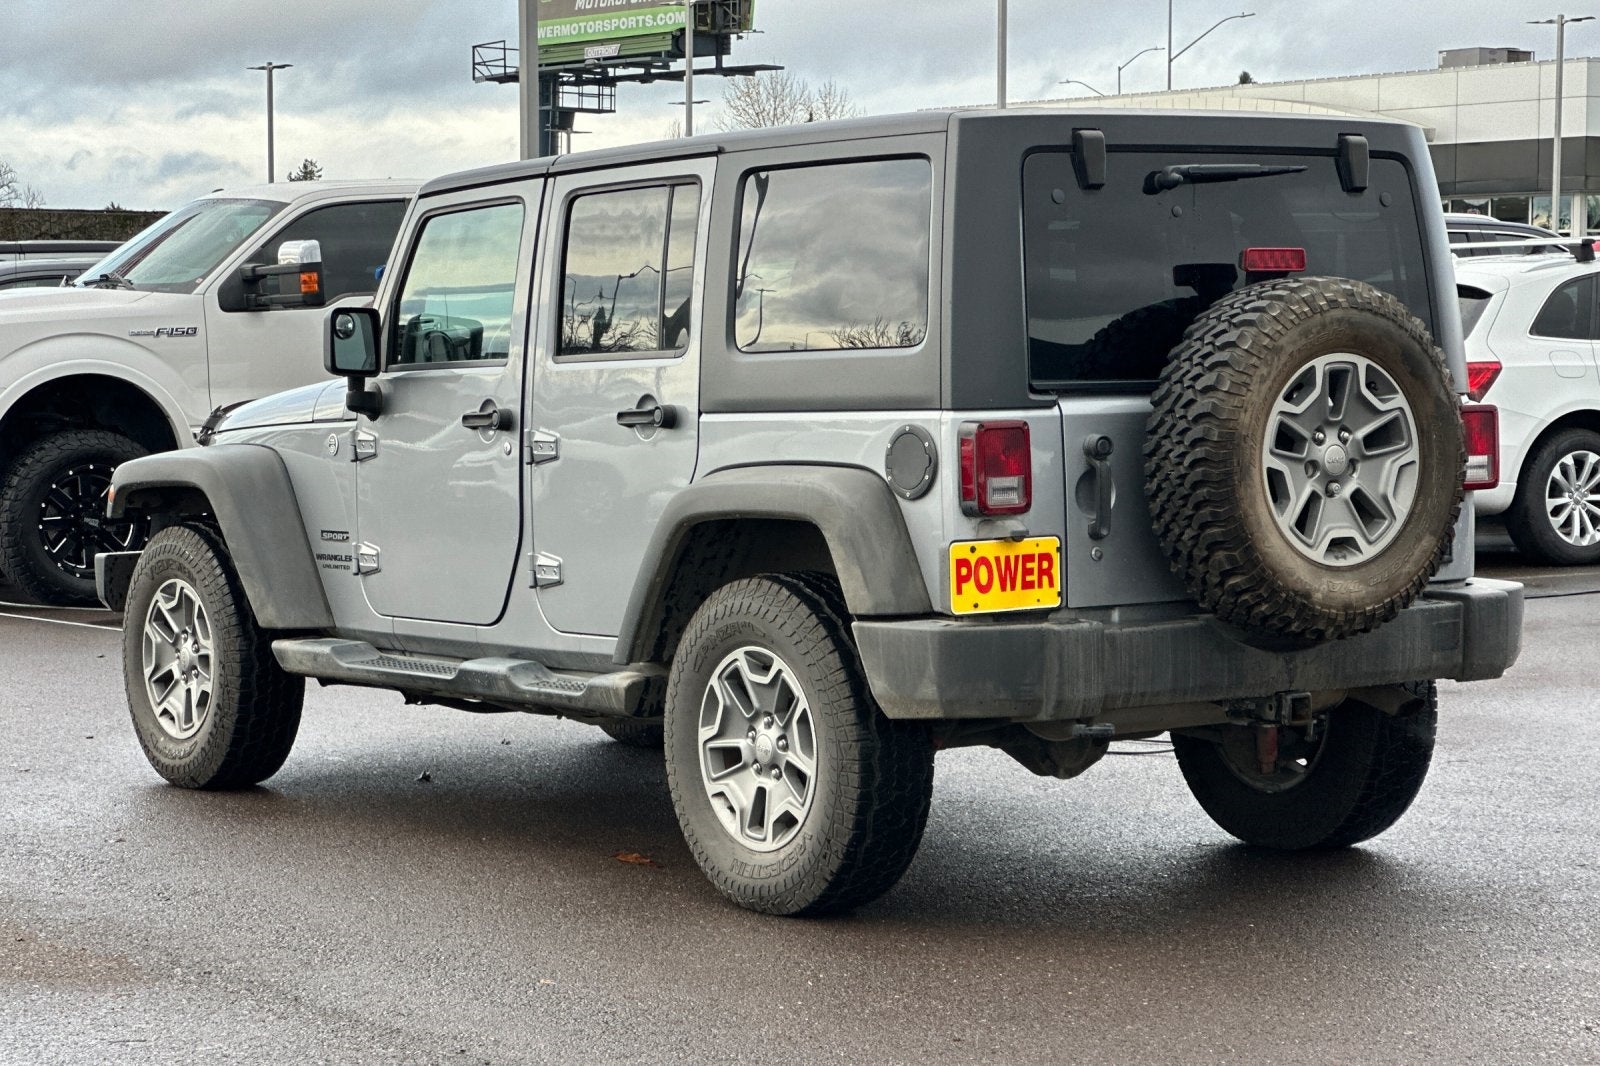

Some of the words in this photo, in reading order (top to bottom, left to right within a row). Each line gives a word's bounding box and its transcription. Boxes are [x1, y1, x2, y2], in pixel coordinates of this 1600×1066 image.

[322, 532, 348, 540] SPORT
[323, 563, 351, 571] UNLIMITED
[955, 552, 1055, 596] POWER
